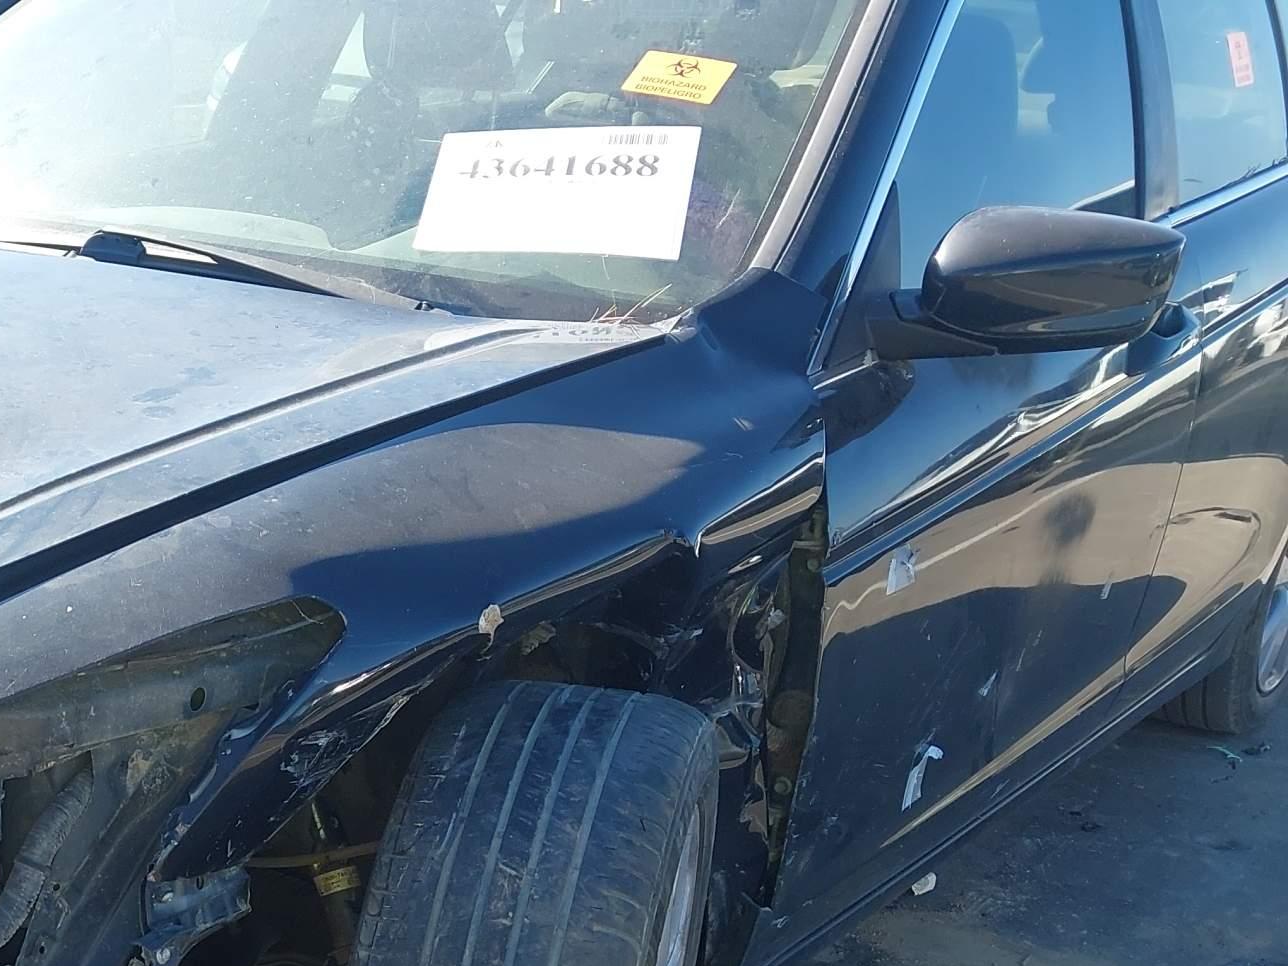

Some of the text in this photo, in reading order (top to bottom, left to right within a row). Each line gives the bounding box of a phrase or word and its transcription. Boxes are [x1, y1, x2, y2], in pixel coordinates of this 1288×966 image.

[634, 83, 702, 100] BIOPELIGRO
[640, 75, 707, 92] BIOHAZARD
[458, 154, 661, 179] 43641688
